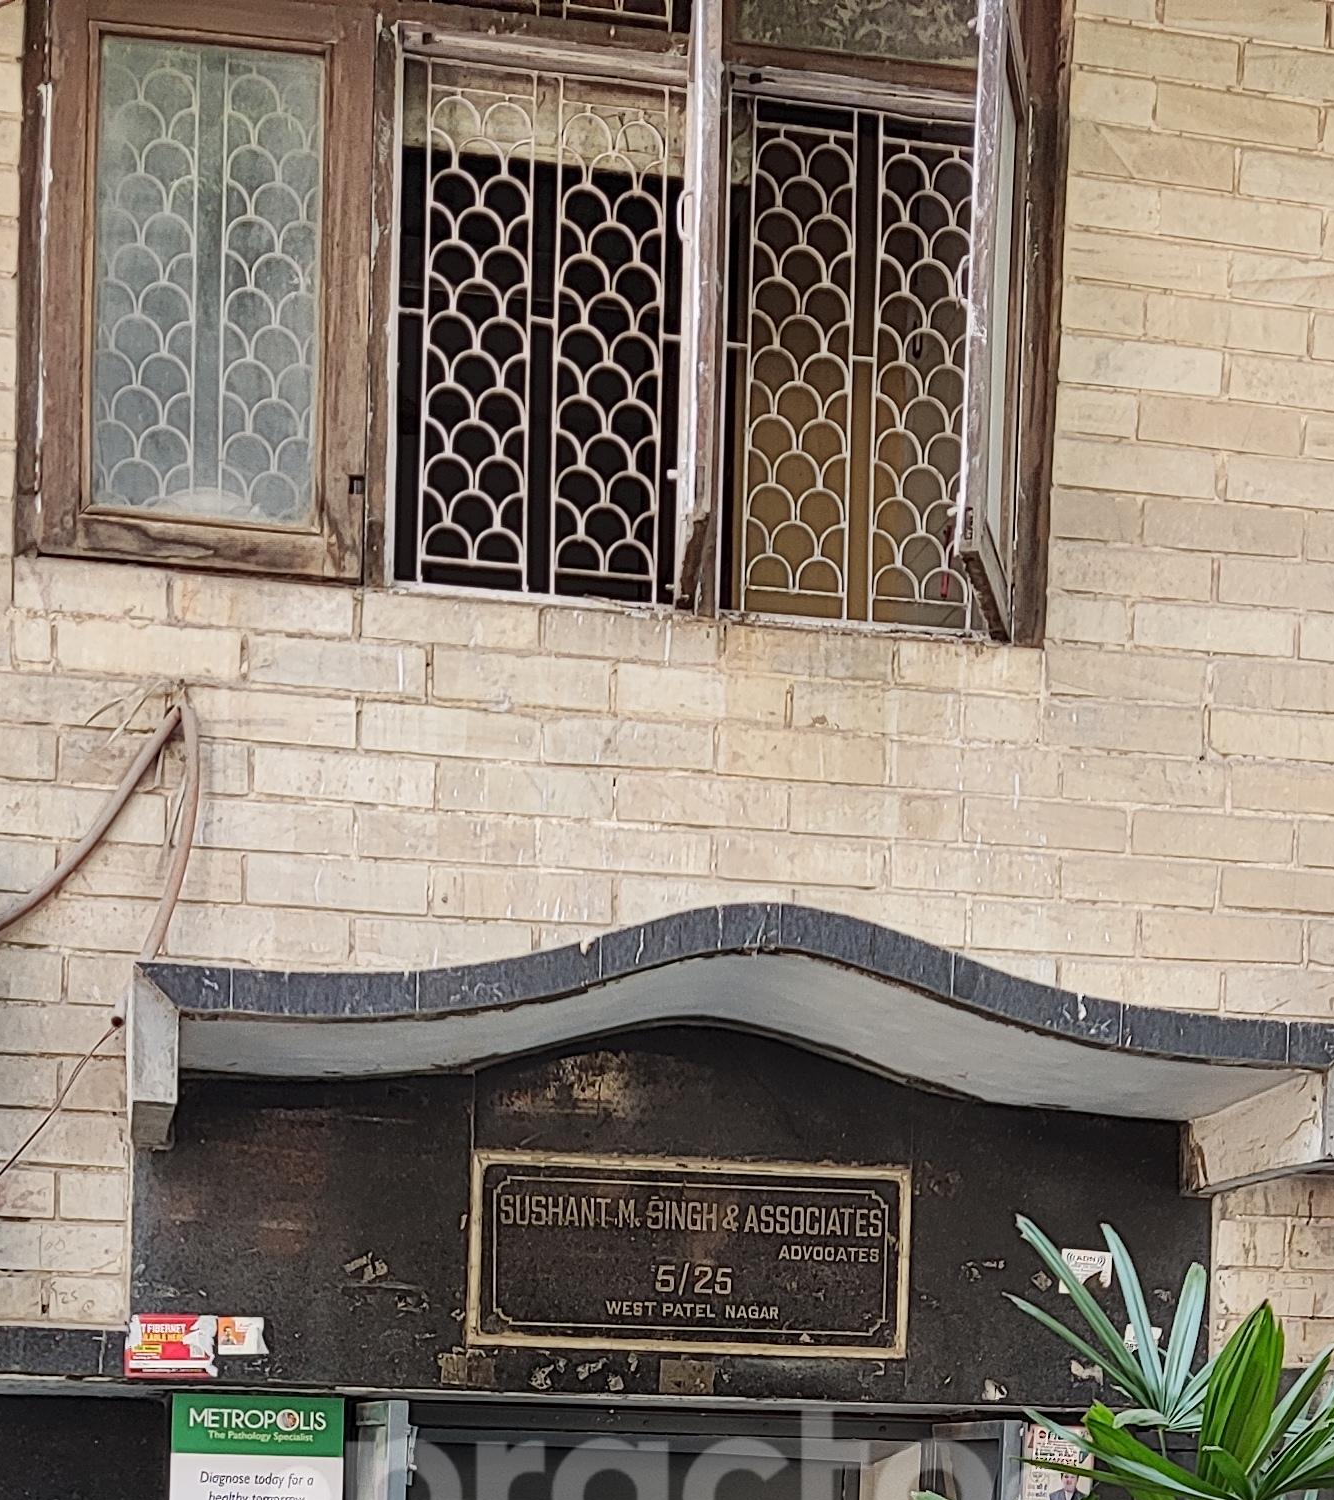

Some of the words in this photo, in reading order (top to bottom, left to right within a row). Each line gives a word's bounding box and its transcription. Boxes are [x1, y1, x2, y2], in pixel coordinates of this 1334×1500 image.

[500, 1194, 611, 1229] SUSHANT
[646, 1201, 718, 1232] SINGH
[722, 1204, 739, 1232] &
[743, 1205, 882, 1237] ASSOCIATES
[778, 1245, 879, 1263] ADVOCATES
[654, 1264, 732, 1297] 5/25
[605, 1300, 657, 1316] WEST
[662, 1303, 716, 1318] PATEL
[725, 1304, 779, 1320] NAGAR
[189, 1408, 327, 1432] METROPOLIS
[200, 1470, 250, 1487] Diagnose
[254, 1472, 285, 1487] today
